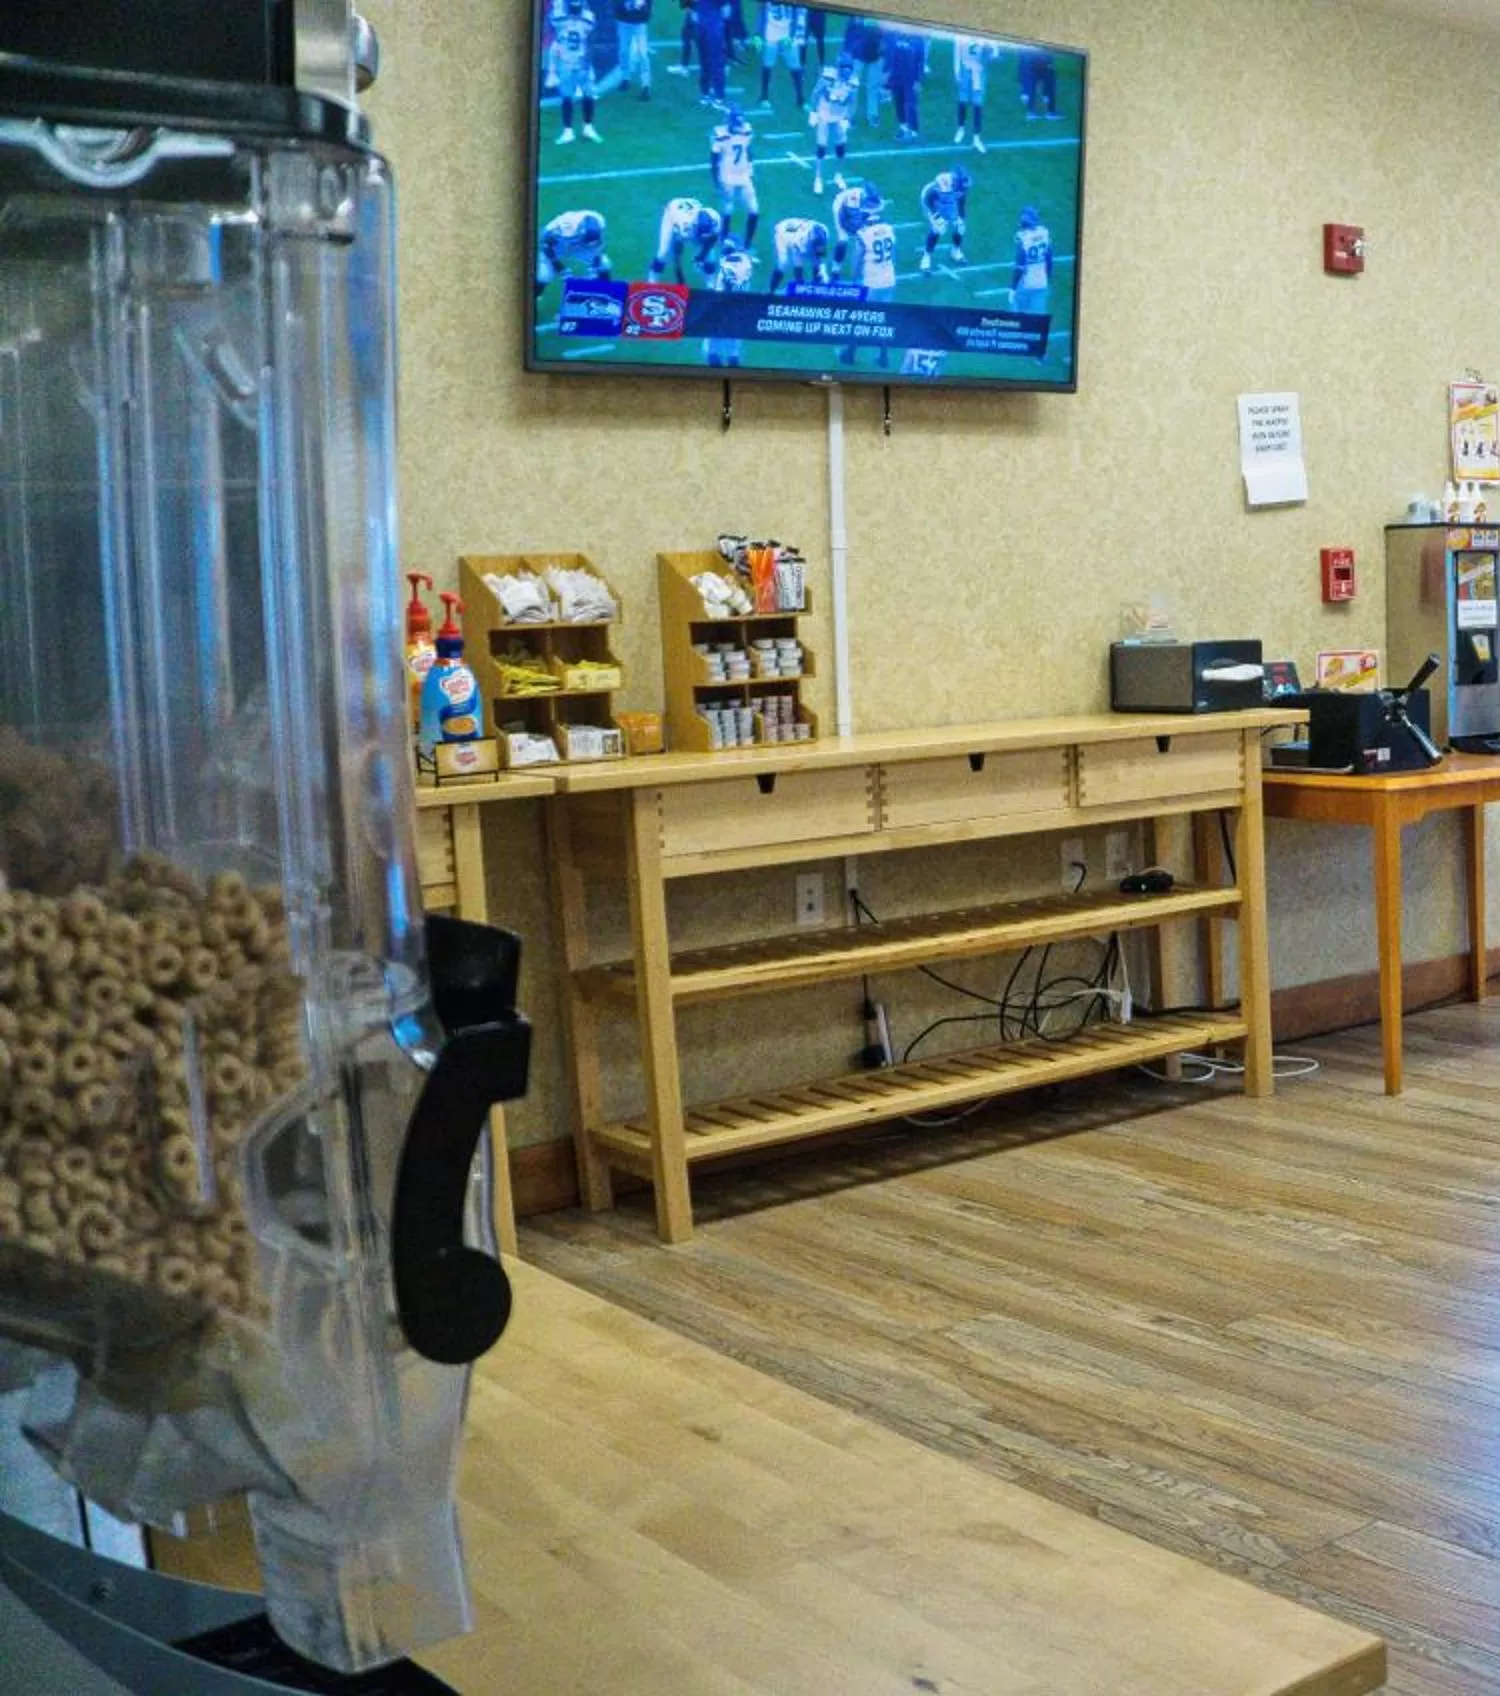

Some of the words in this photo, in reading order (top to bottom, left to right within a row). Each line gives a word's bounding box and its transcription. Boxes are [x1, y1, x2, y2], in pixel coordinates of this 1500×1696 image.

[767, 304, 832, 319] SEAHAWKS
[833, 309, 849, 321] AT
[850, 310, 886, 323] 49ERS
[757, 318, 803, 333] COMING
[805, 321, 821, 333] UP
[823, 322, 852, 335] NEXT
[853, 325, 870, 337] ON
[872, 326, 896, 338] FOX
